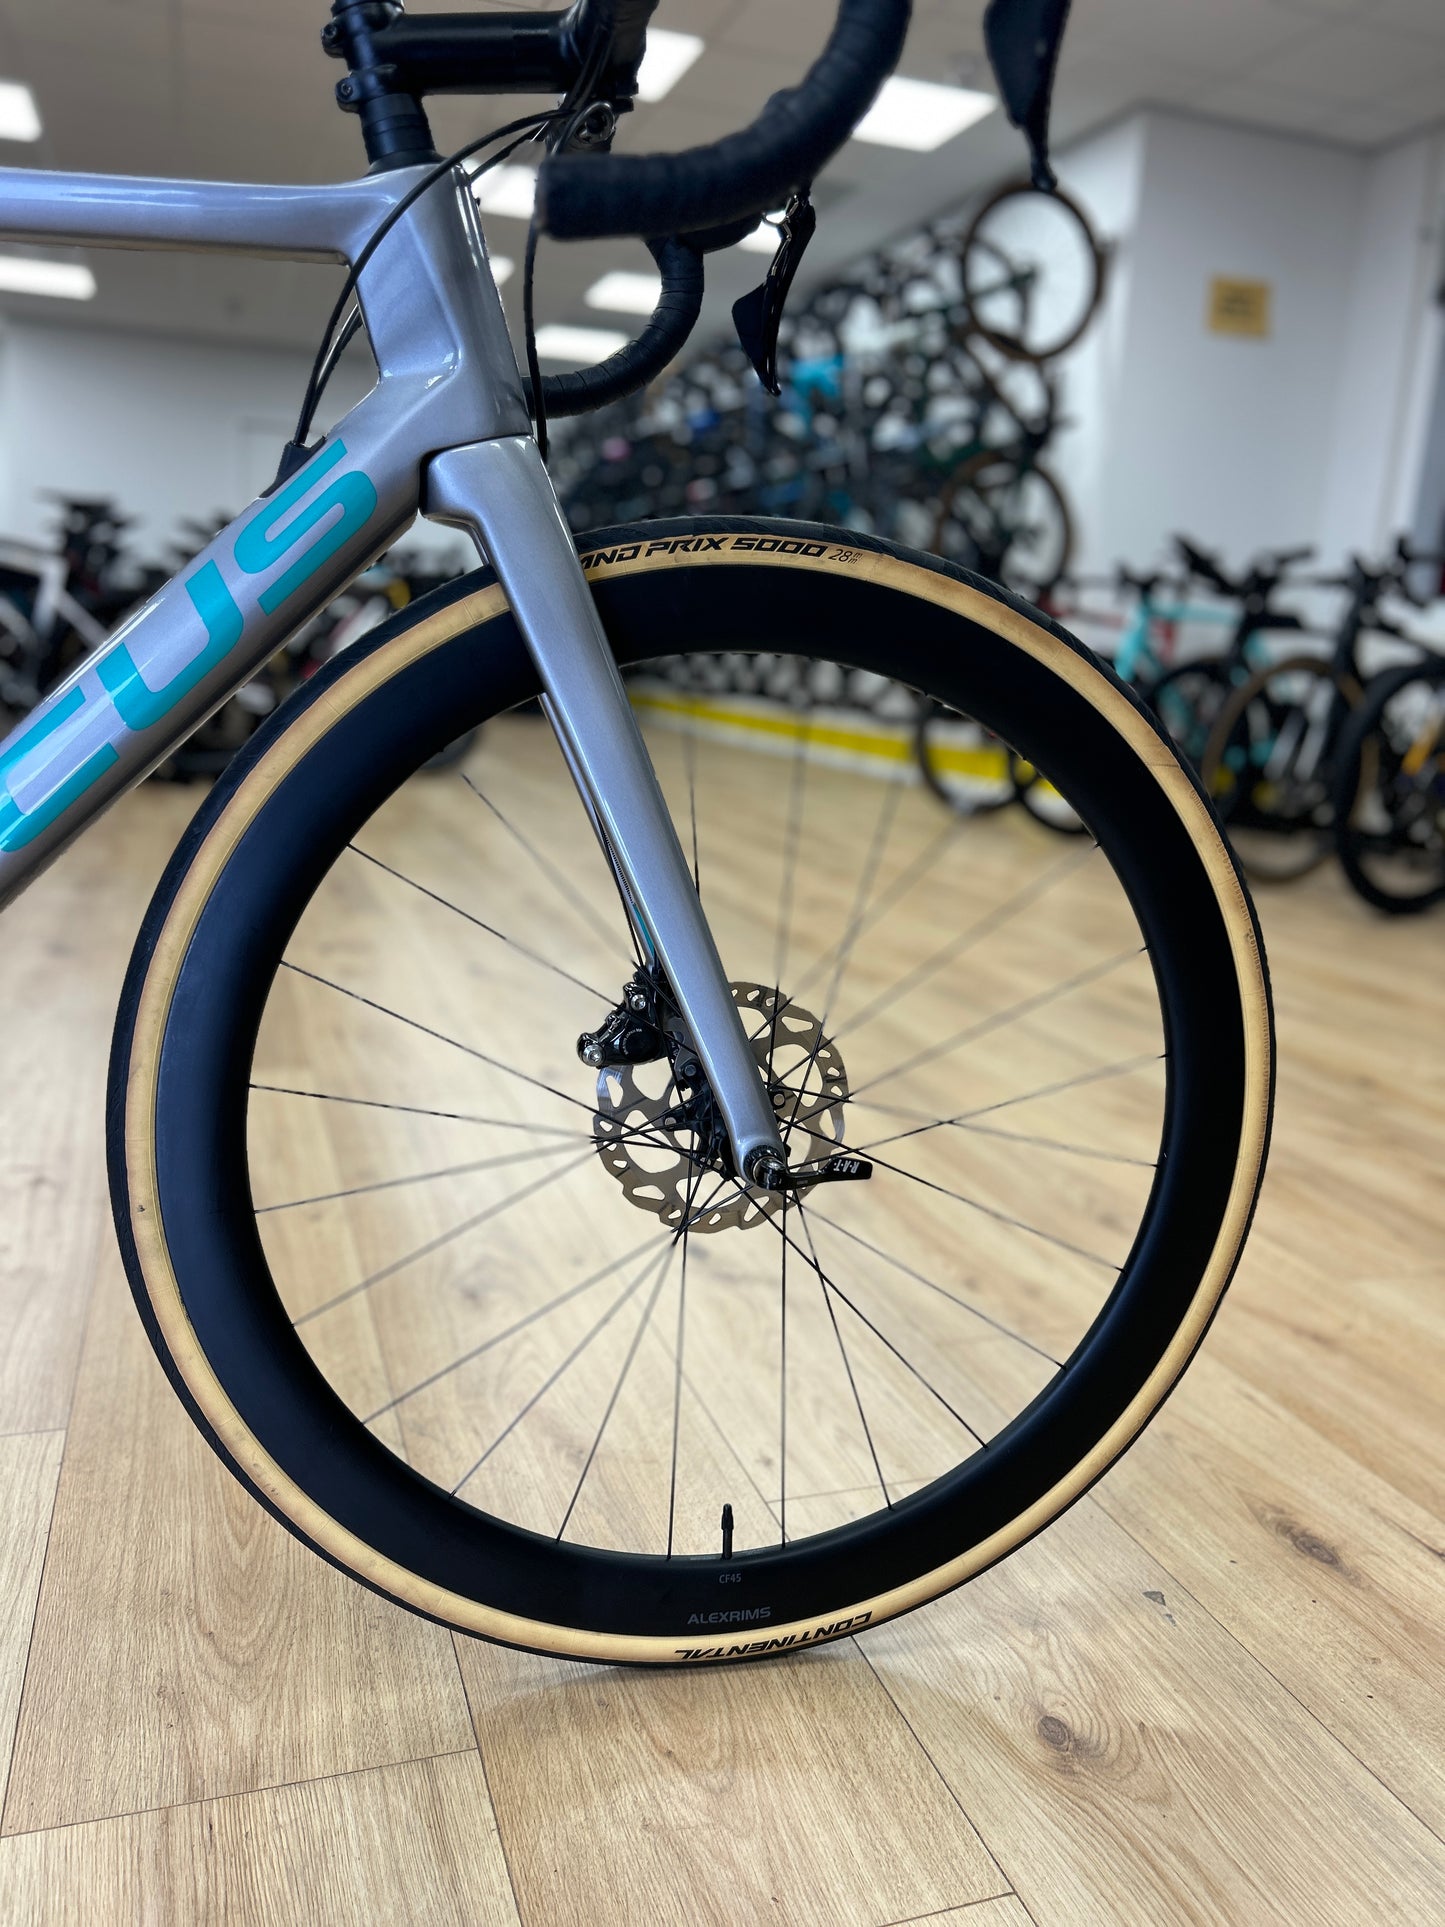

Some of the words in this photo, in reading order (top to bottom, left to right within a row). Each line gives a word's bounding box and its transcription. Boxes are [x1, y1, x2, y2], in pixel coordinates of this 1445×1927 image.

[645, 537, 729, 558] PRIX
[730, 537, 828, 557] 5000
[719, 1573, 742, 1584] CF45
[687, 1606, 772, 1625] ALEXRIMS
[675, 1610, 873, 1660] CONTINENTAL
